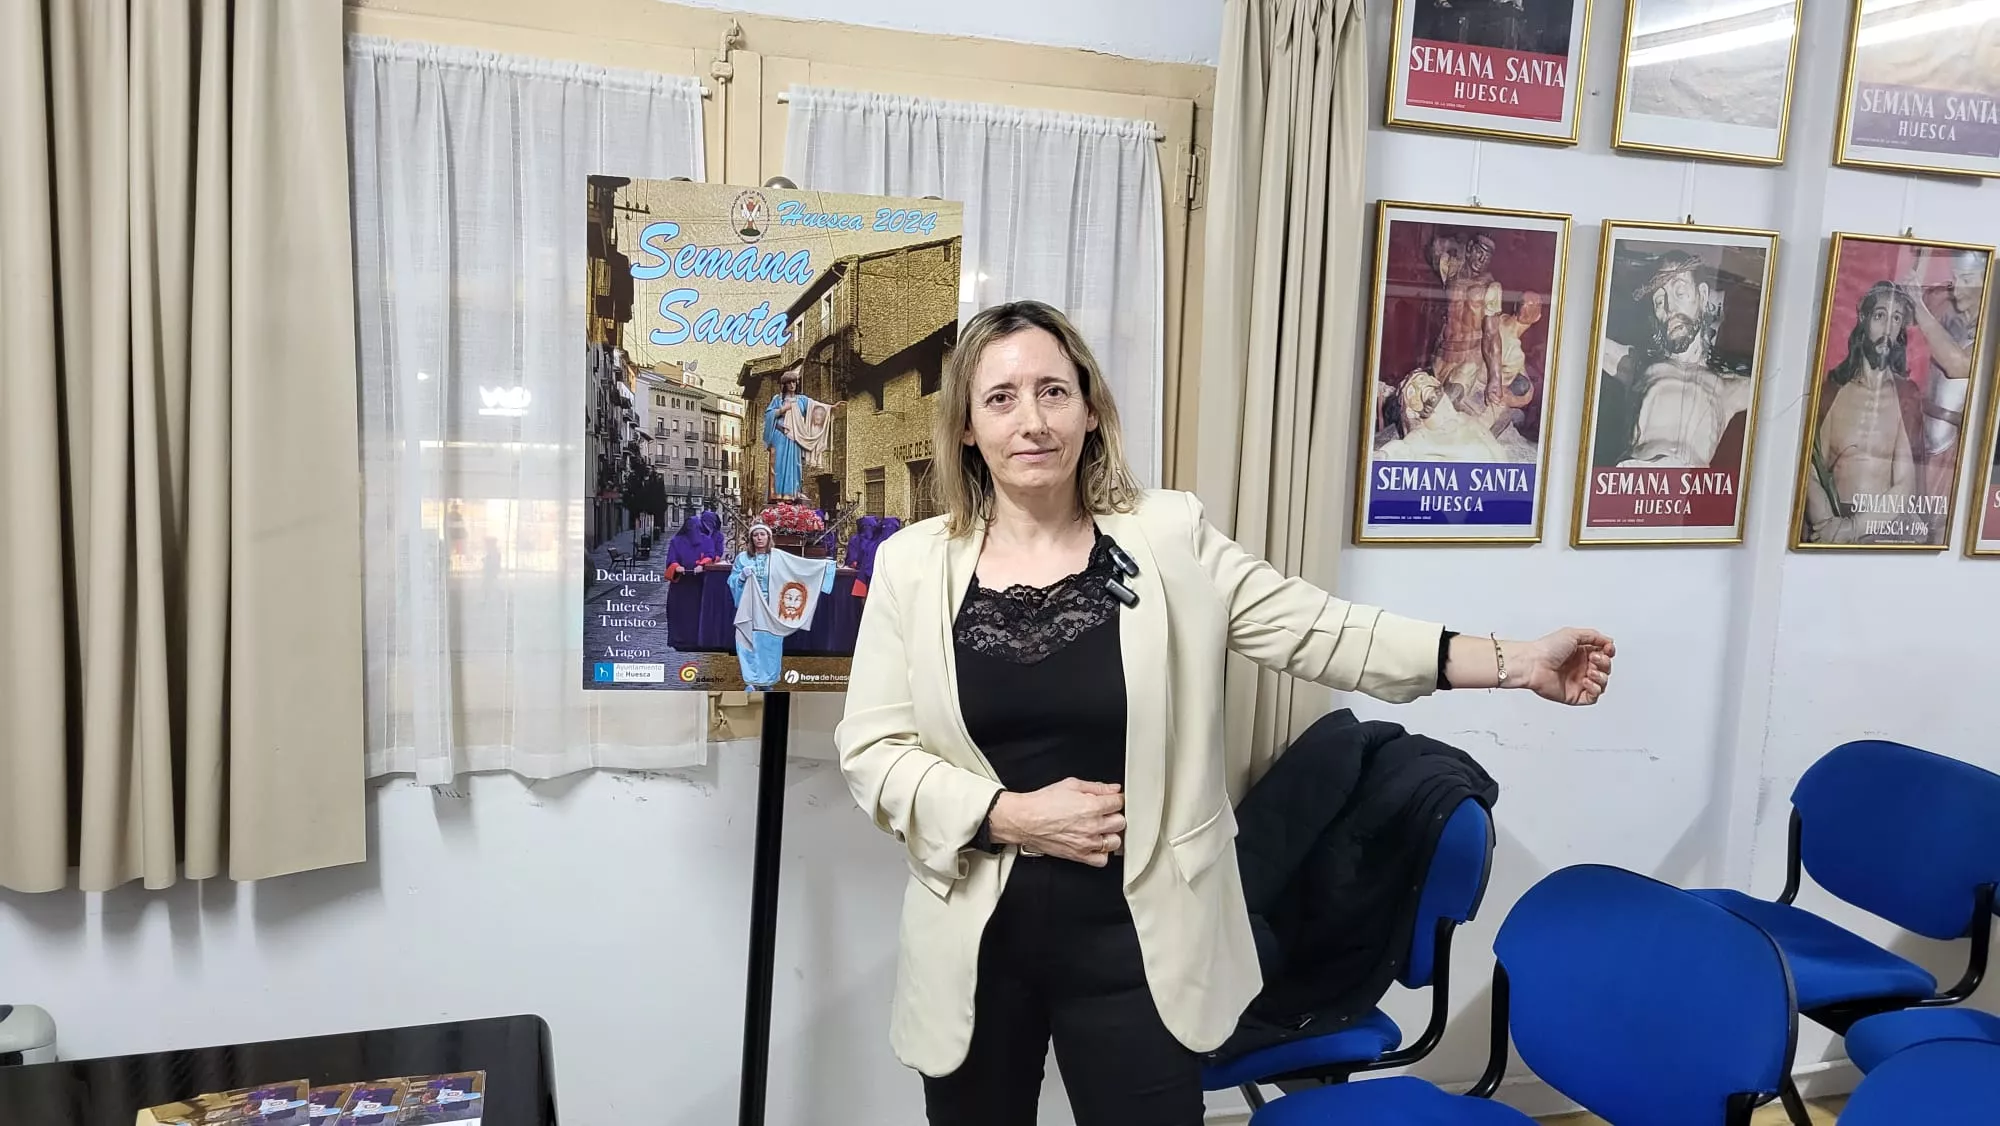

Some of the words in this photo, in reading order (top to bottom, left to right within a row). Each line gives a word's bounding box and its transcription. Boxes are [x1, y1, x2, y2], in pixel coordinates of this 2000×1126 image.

[1410, 45, 1494, 80] SEMANA
[1505, 56, 1565, 88] SANTA
[1454, 81, 1519, 105] HUESCA
[1860, 88, 1935, 119] SEMANA
[1944, 96, 1998, 125] SANTA
[1898, 120, 1956, 141] HUESCA
[777, 200, 864, 231] Huesca
[872, 207, 938, 236] 2024
[630, 221, 814, 287] Semana
[649, 288, 793, 348] Santa
[1377, 466, 1459, 491] SEMANA
[1469, 468, 1528, 492] SANTA
[1595, 472, 1670, 495] SEMANA
[1679, 472, 1733, 495] SANTA
[1420, 495, 1484, 512] HUESCA
[1634, 499, 1692, 515] HUESCA
[1850, 493, 1905, 514] SEMANA
[1907, 494, 1948, 515] SANTA
[1865, 520, 1904, 536] HUESCA
[1910, 521, 1929, 536] 1996
[595, 568, 661, 583] Declarada
[619, 585, 637, 597] de
[605, 599, 650, 613] Interés
[598, 613, 657, 628] Turístico
[615, 630, 632, 642] de
[603, 646, 651, 660] Aragón
[615, 664, 662, 672] Ayuntamiento
[800, 673, 820, 682] hoya
[820, 673, 829, 681] de
